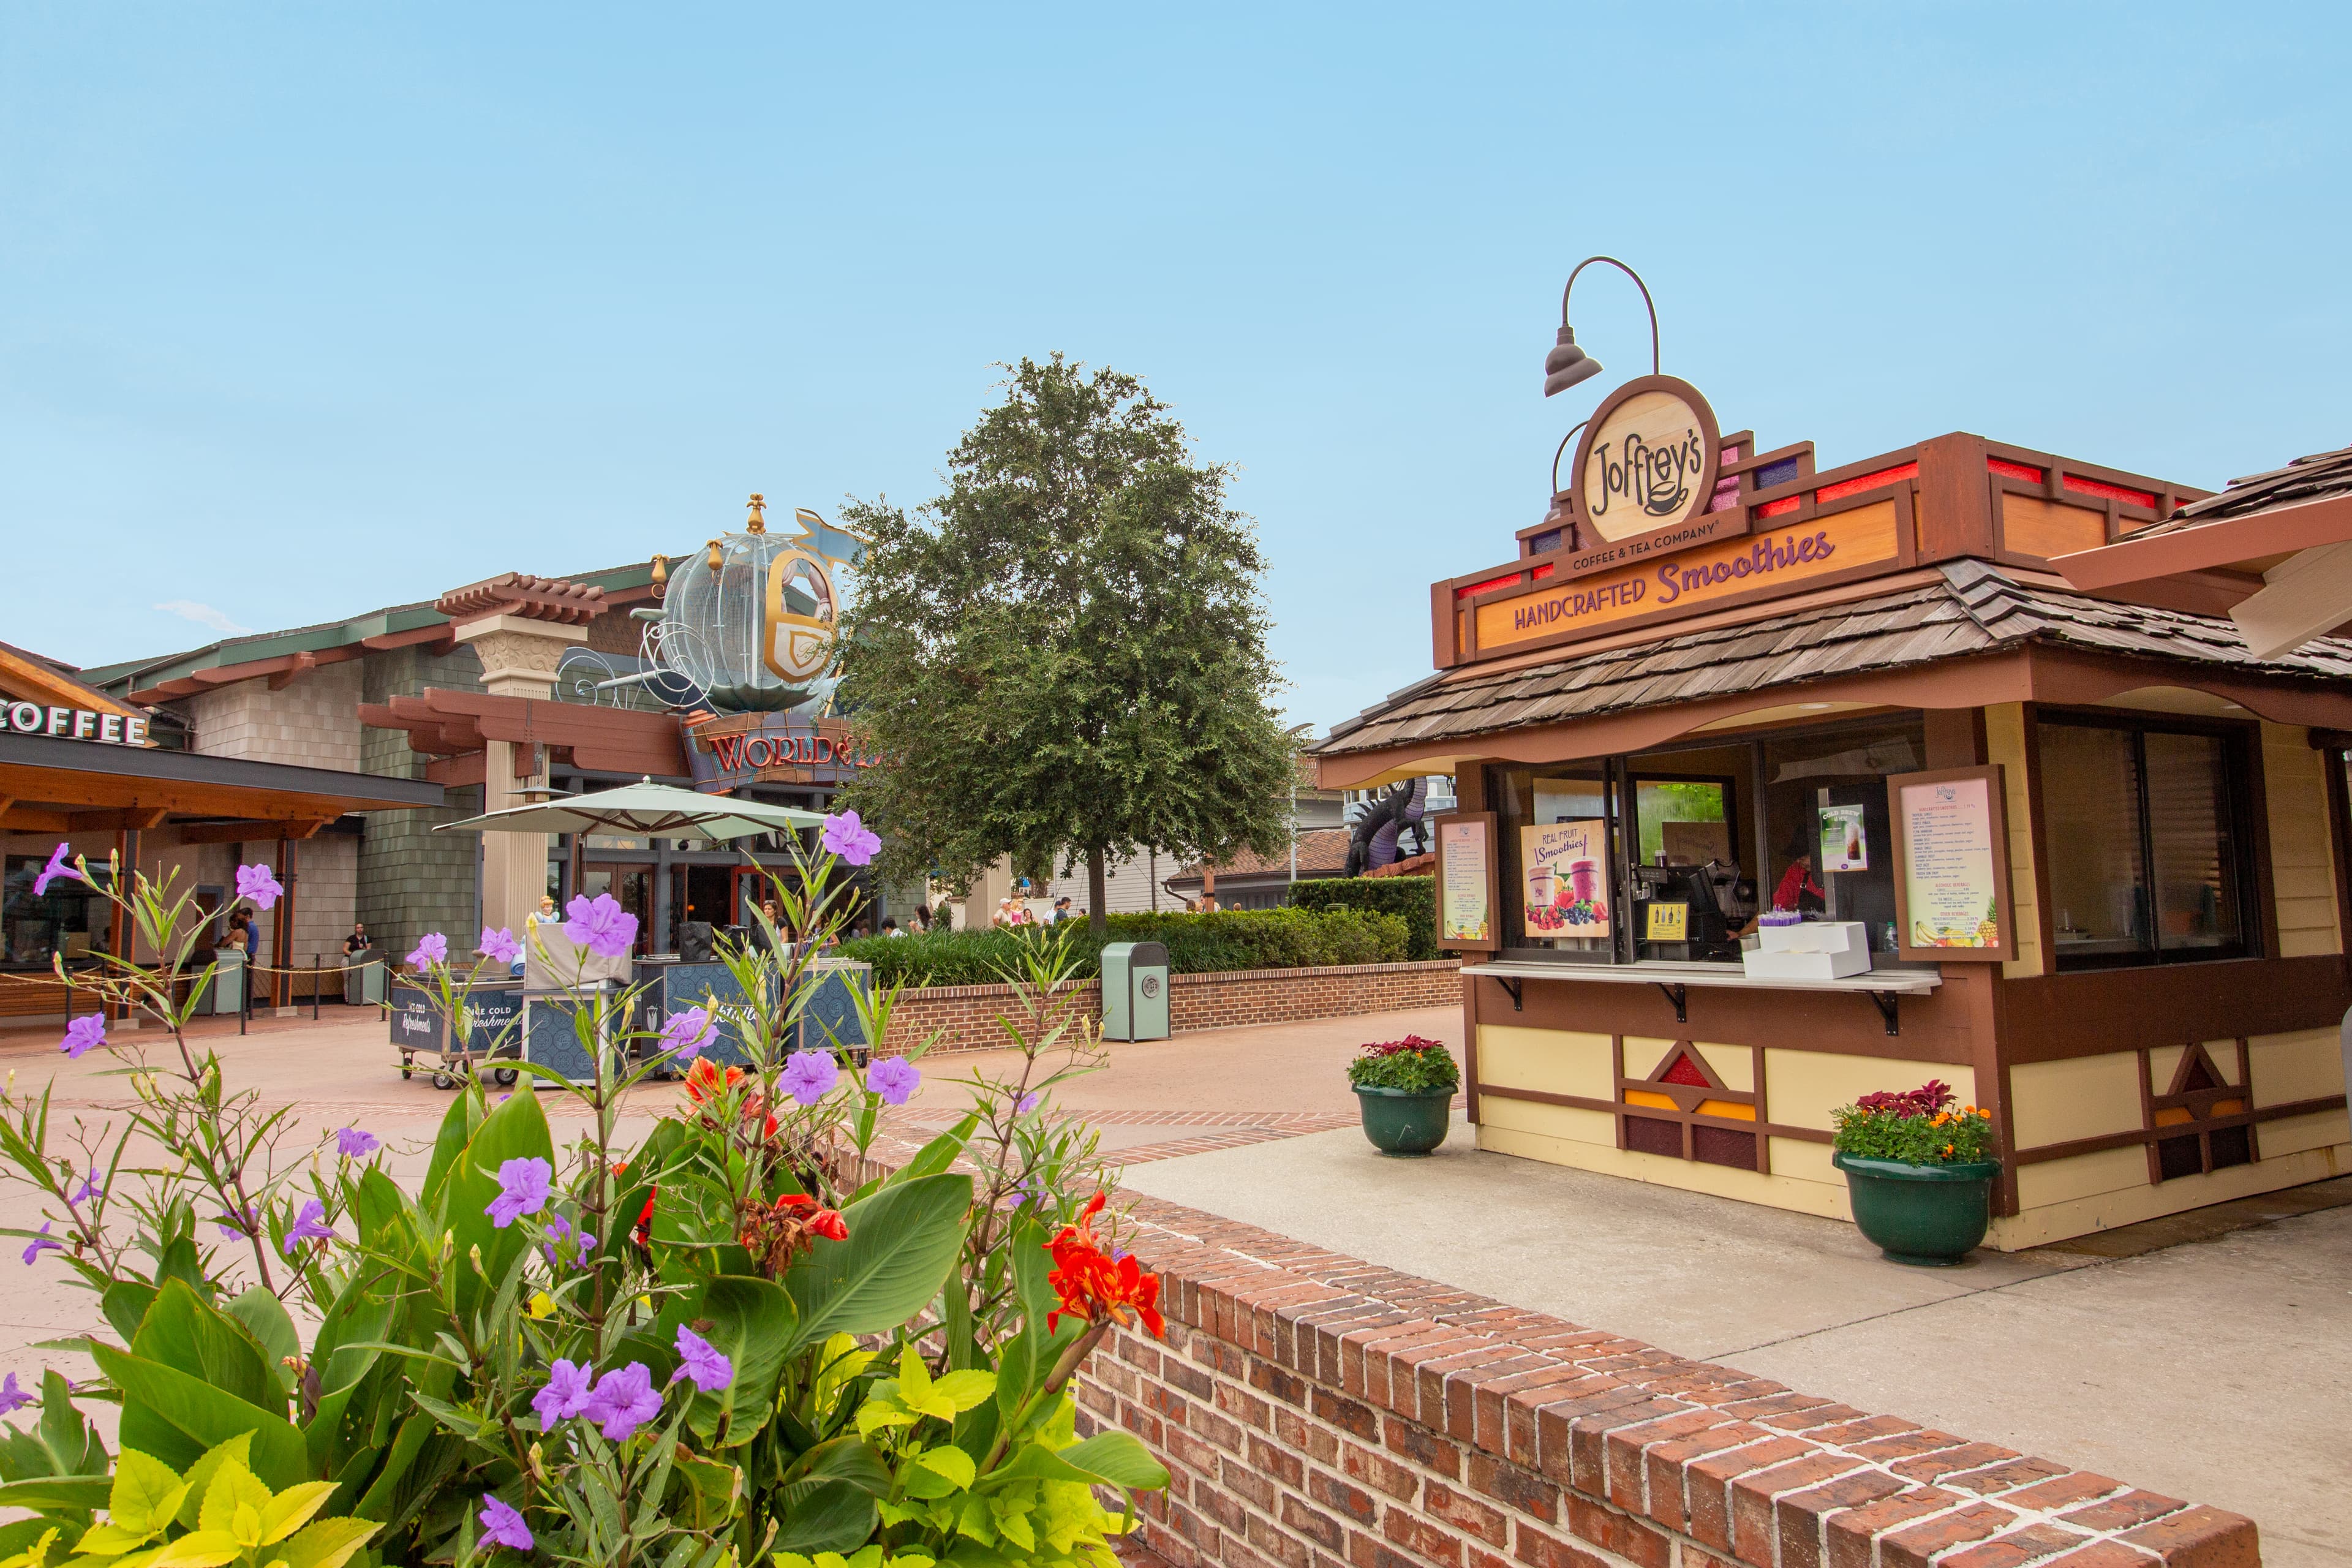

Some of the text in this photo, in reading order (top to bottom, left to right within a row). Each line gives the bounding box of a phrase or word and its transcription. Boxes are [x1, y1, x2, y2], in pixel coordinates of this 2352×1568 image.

[1592, 429, 1701, 516] Joffrey's
[1574, 550, 1615, 570] COFFEE
[1618, 548, 1626, 558] &
[1629, 542, 1651, 556] TEA
[1514, 531, 1835, 630] HANDCRAFTED Smoothies
[707, 733, 833, 771] WORLD
[1822, 810, 1839, 820] COLD
[1542, 828, 1578, 845] REAL FRUIT
[1538, 839, 1583, 863] Smoothies
[416, 1003, 426, 1013] COLD
[489, 1006, 511, 1015] COLD
[402, 1013, 431, 1036] Refreshments
